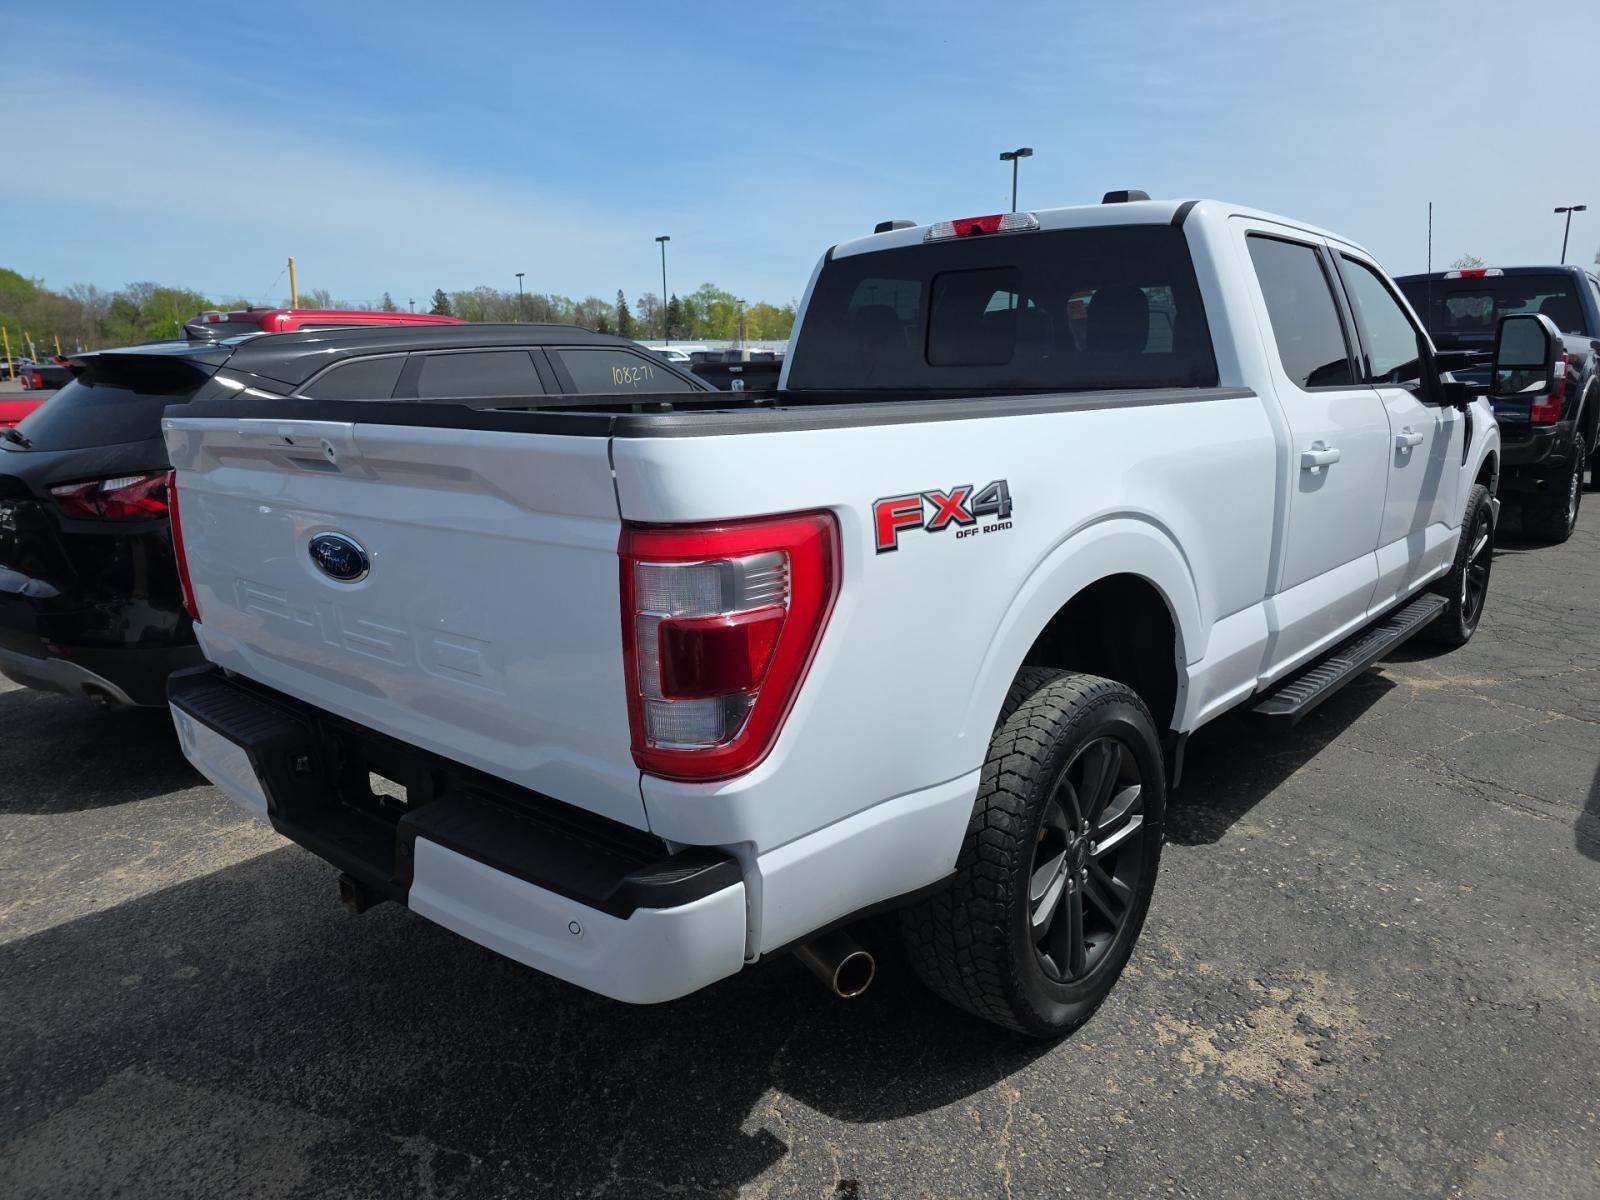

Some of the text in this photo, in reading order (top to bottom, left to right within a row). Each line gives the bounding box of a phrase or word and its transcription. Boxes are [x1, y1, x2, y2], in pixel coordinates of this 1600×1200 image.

[612, 365, 654, 388] 108271
[872, 479, 1013, 555] FX4
[956, 521, 1013, 539] OFF ROAD
[316, 541, 353, 574] Ford
